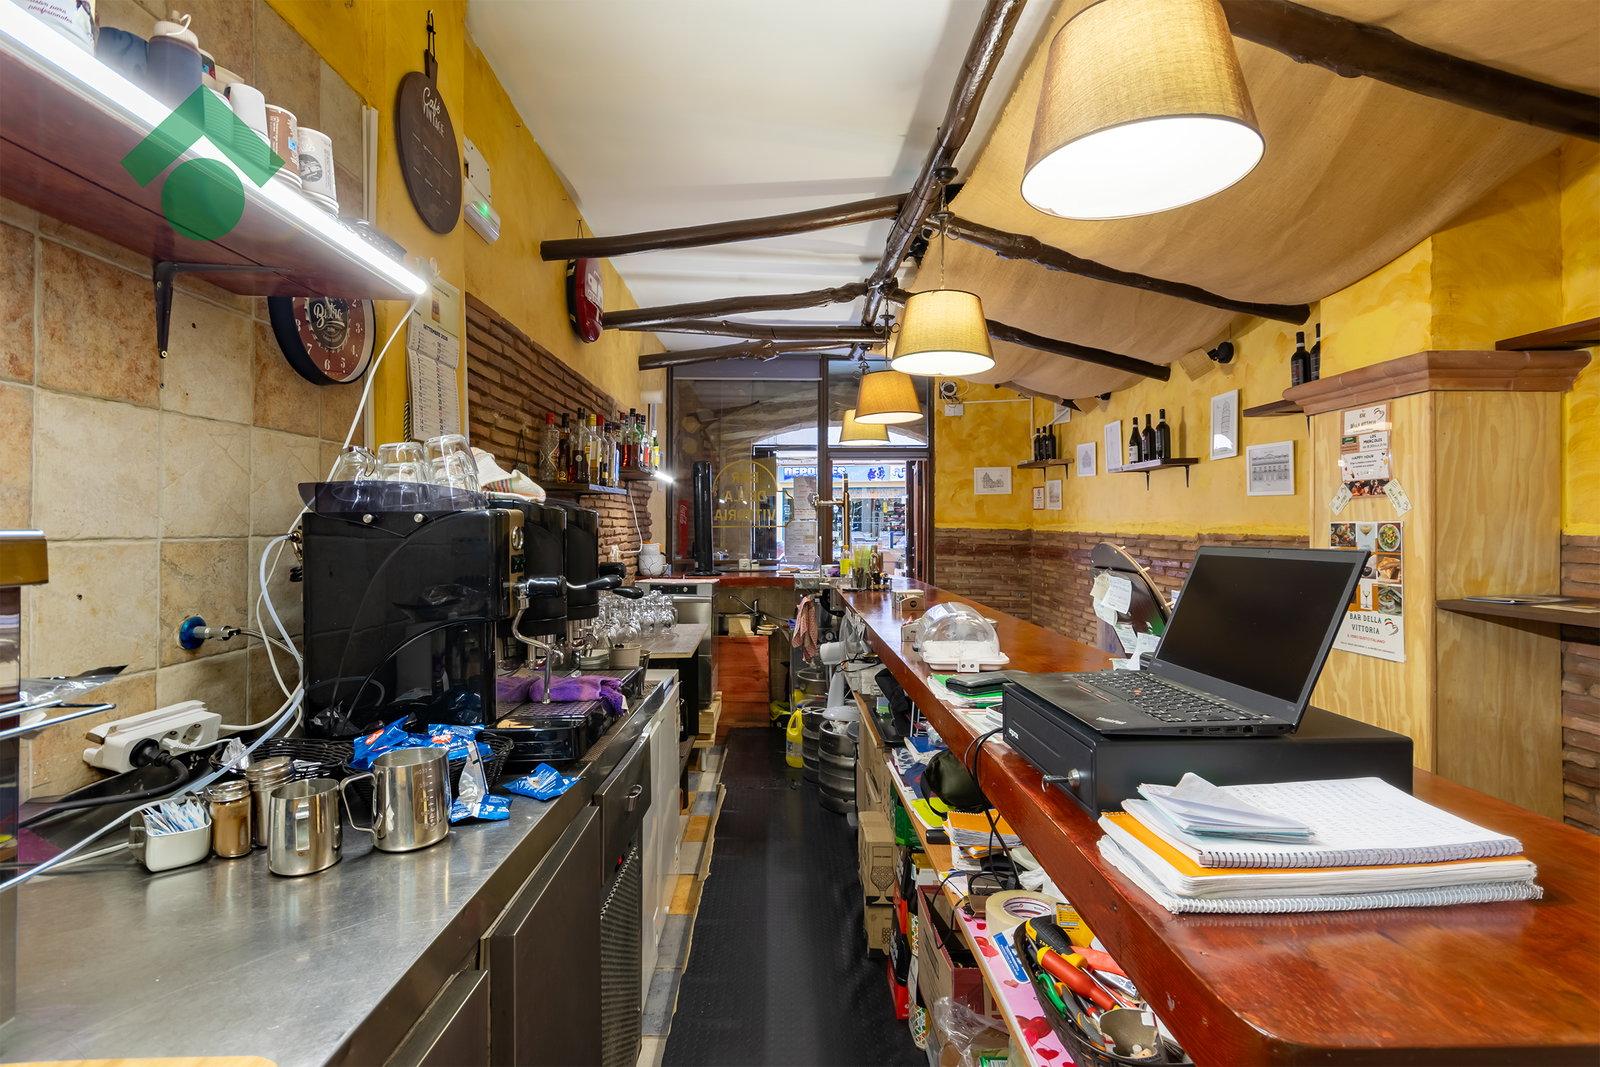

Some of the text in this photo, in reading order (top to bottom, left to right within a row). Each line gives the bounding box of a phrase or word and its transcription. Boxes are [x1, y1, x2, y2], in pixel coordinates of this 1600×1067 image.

[784, 466, 848, 480] DEPOES
[1349, 613, 1382, 624] BAR DELLA
[1351, 624, 1380, 635] VITTORIA
